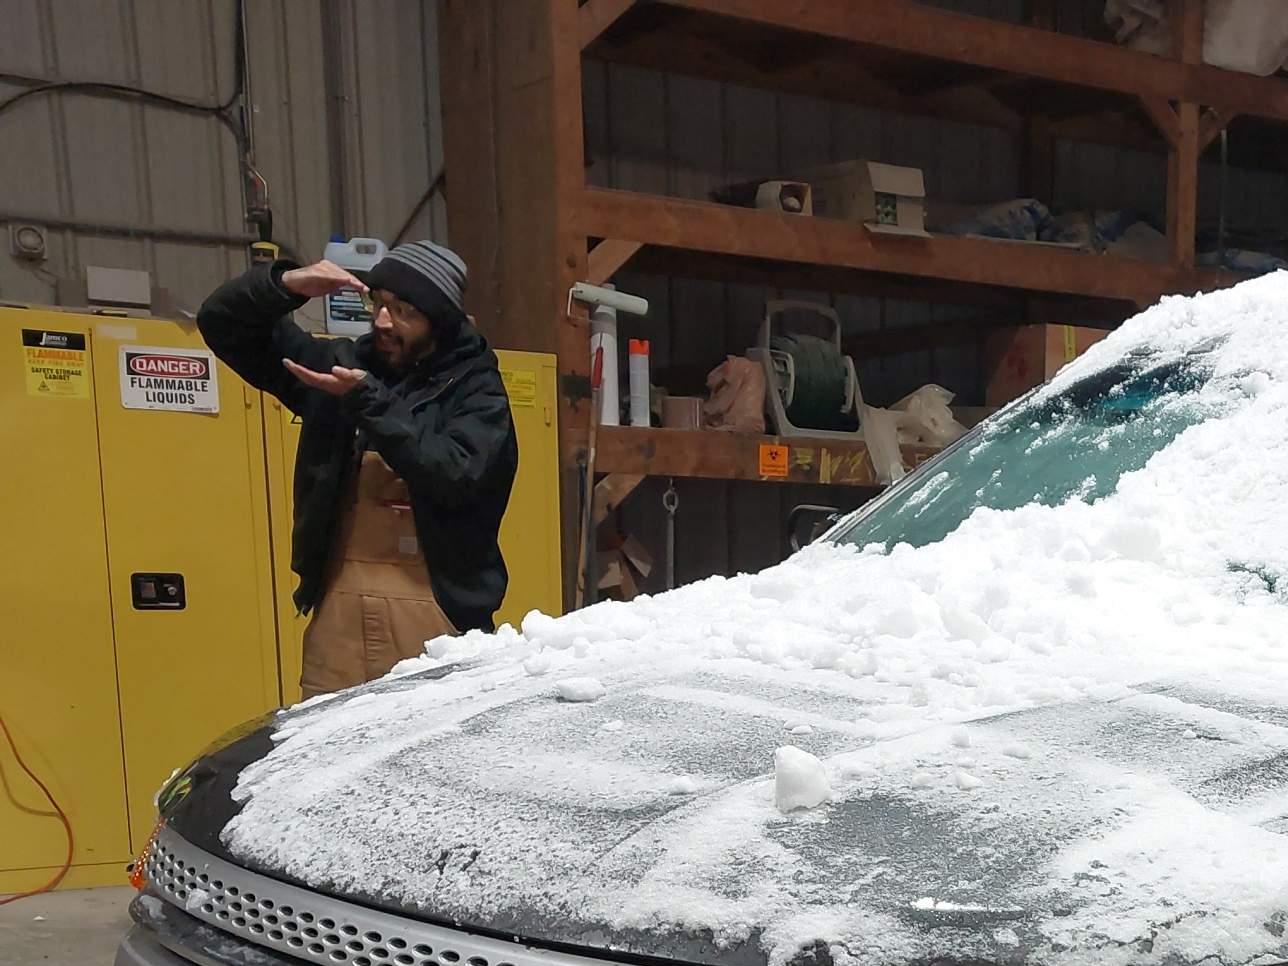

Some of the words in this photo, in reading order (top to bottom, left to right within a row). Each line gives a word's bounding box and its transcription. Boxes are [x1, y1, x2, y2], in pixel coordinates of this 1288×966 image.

[26, 349, 85, 362] FLAMMABLE
[31, 367, 54, 375] SAFETY
[55, 368, 82, 377] STORAGE
[135, 358, 201, 375] DANGER
[130, 376, 209, 393] FLAMMABLE
[145, 391, 196, 405] LIQUIDS
